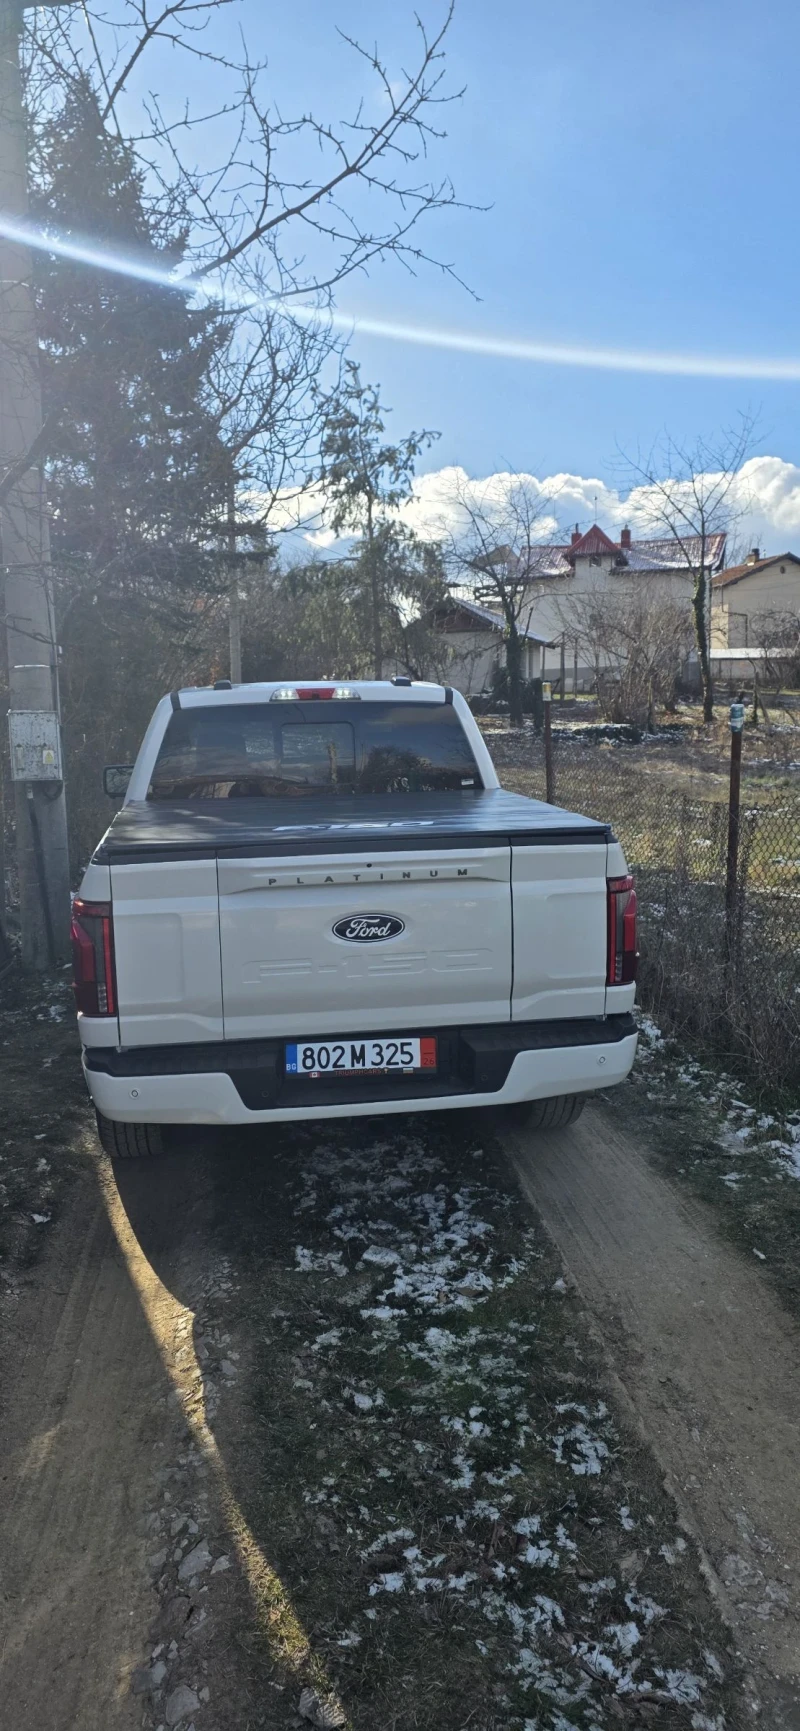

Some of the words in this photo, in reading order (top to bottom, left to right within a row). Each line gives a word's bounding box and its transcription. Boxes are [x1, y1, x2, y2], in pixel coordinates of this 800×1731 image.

[268, 869, 468, 885] PLATINUM
[345, 918, 391, 938] Ford
[242, 948, 493, 984] F-150
[301, 1045, 346, 1070] 802
[350, 1044, 366, 1068] M
[371, 1042, 414, 1067] 325
[423, 1057, 435, 1065] 26
[286, 1063, 297, 1071] BG
